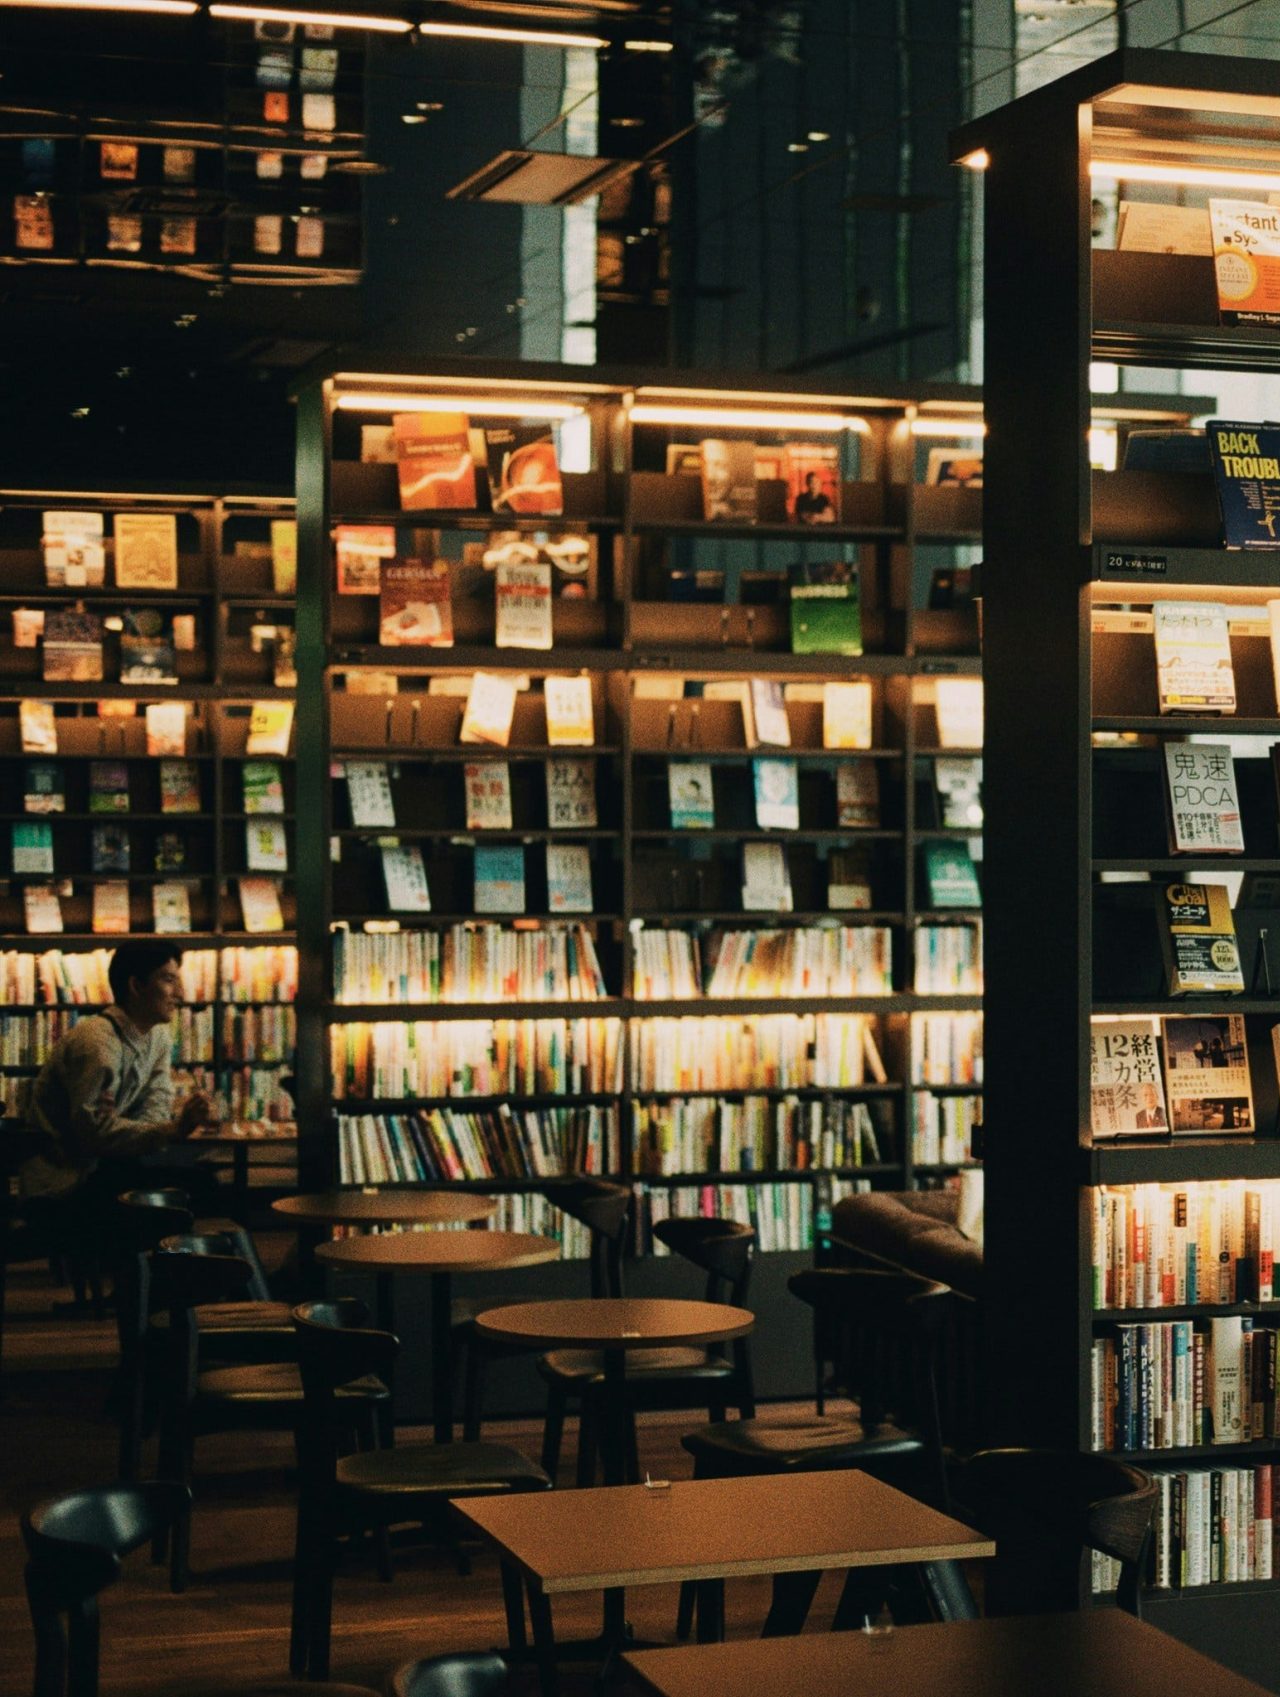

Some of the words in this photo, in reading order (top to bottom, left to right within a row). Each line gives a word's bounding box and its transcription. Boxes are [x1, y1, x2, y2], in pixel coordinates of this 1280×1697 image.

[1217, 432, 1260, 455] BACK
[1109, 556, 1123, 567] 20
[1175, 753, 1231, 781] 鬼速
[1173, 785, 1235, 807] PDCA
[1171, 906, 1207, 917] ザ・ゴール
[1131, 1034, 1156, 1082] 経営
[1122, 1332, 1130, 1380] KPI
